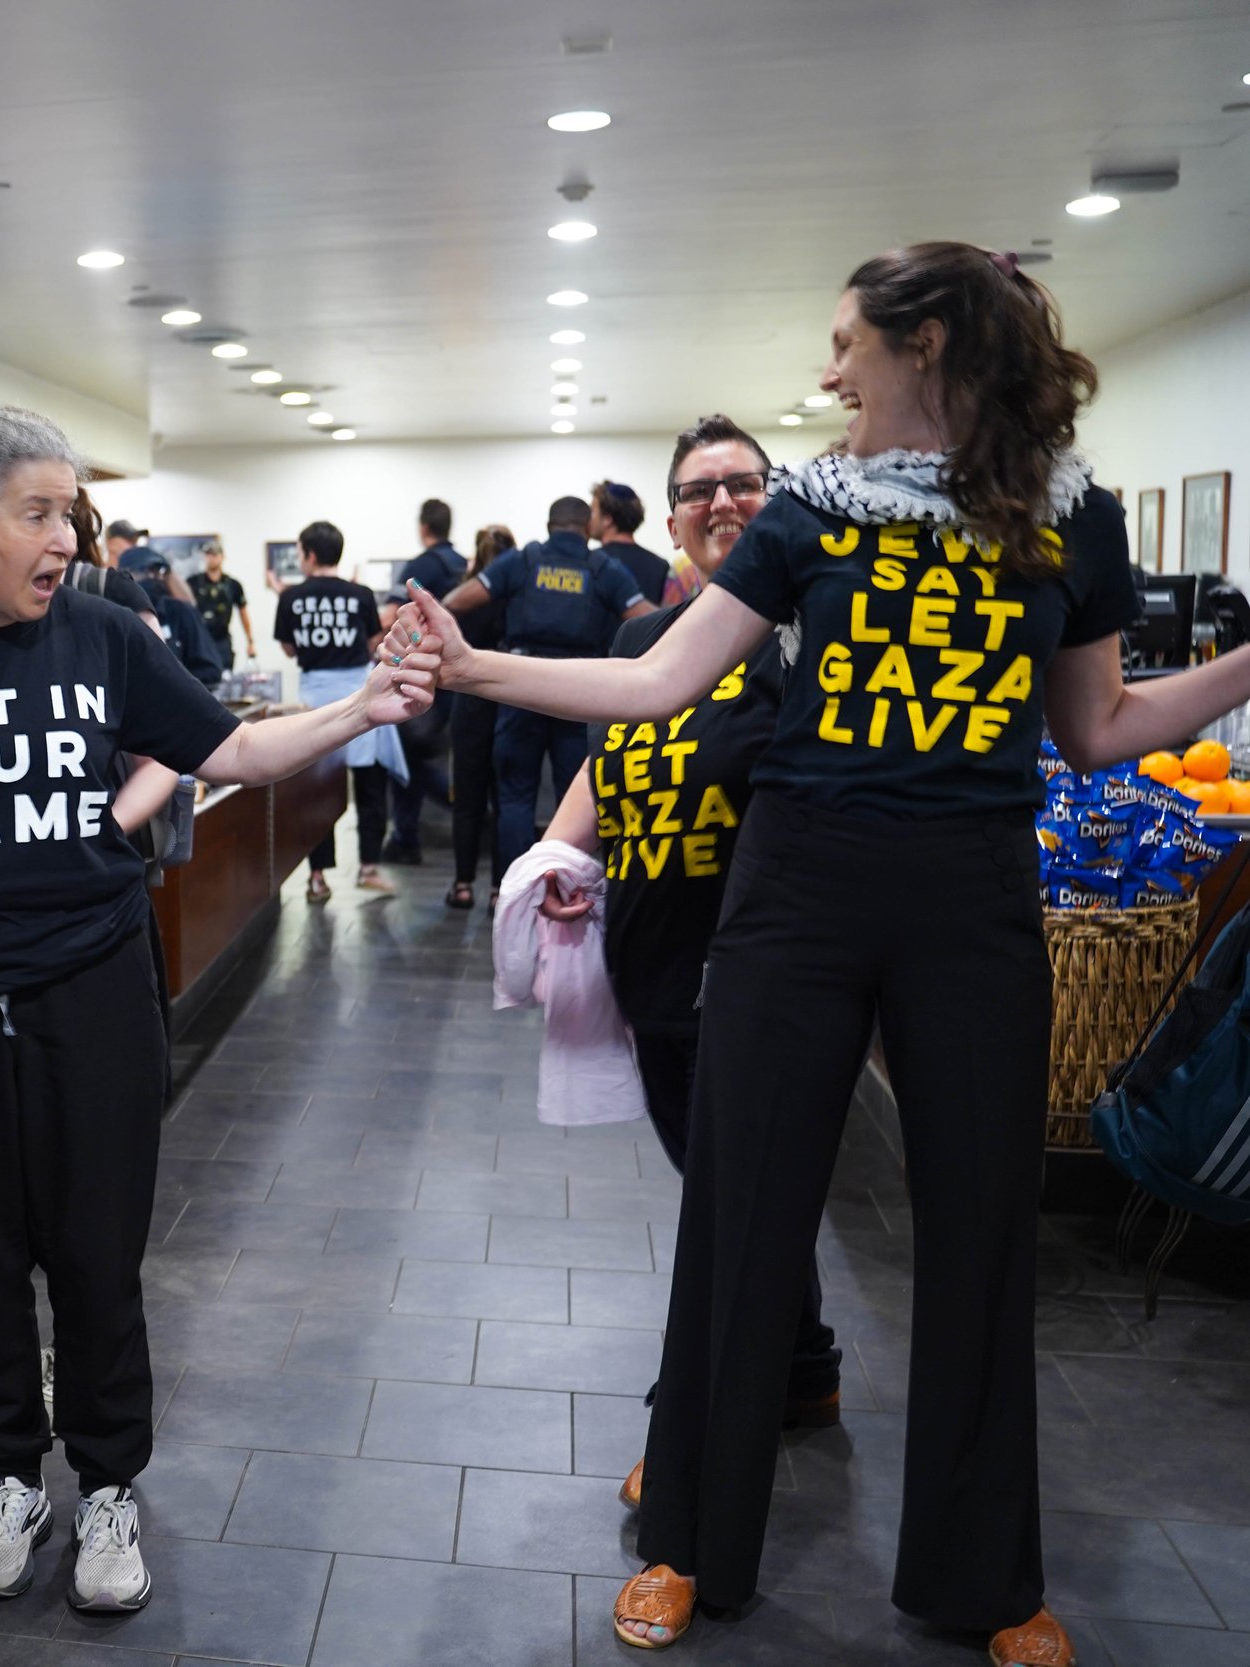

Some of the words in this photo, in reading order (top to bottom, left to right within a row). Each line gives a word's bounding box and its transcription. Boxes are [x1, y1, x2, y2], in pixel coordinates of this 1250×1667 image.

[536, 573, 583, 594] POLICE
[871, 557, 1000, 597] SAY
[292, 596, 359, 615] CEASE
[301, 611, 349, 629] FIRE
[851, 591, 1025, 651] LET
[293, 627, 358, 648] NOW
[818, 641, 1034, 704] GAZA
[50, 684, 106, 724] IN
[604, 706, 697, 752] SAY
[818, 697, 1011, 754] LIVE
[595, 740, 699, 799] LET
[1079, 821, 1128, 838] Doritos
[1171, 829, 1223, 863] Doritos
[1059, 887, 1119, 909] Doritos
